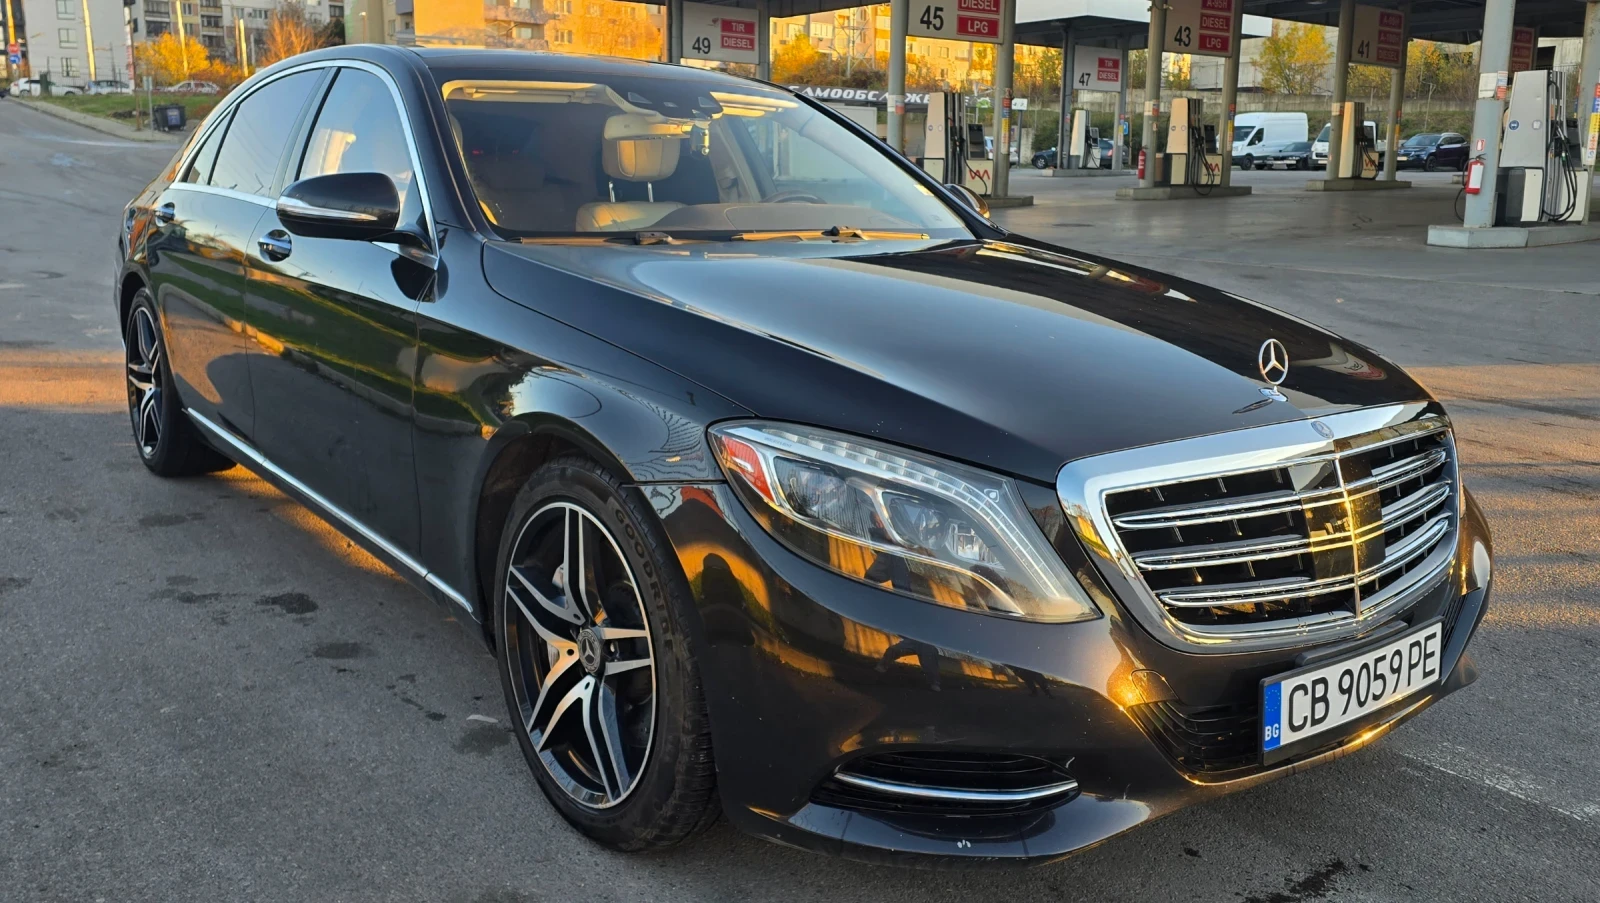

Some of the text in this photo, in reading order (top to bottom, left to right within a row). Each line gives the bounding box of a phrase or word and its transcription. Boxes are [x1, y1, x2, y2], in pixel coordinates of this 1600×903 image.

[961, 0, 997, 11] DIESEL
[920, 5, 944, 31] 45
[1202, 16, 1228, 29] DIESEL
[731, 22, 745, 32] TIR
[967, 20, 989, 33] LPG
[1174, 25, 1192, 47] 43
[692, 36, 711, 54] 49
[723, 37, 752, 49] DIESEL
[1206, 37, 1222, 49] LPG
[1357, 39, 1370, 59] 41
[1377, 49, 1398, 61] DIESEL
[1104, 59, 1114, 67] TIR
[1079, 73, 1091, 86] 47
[1099, 71, 1117, 80] DIESEL
[1288, 632, 1437, 733] CB 9059 PE
[1265, 723, 1280, 742] BG
